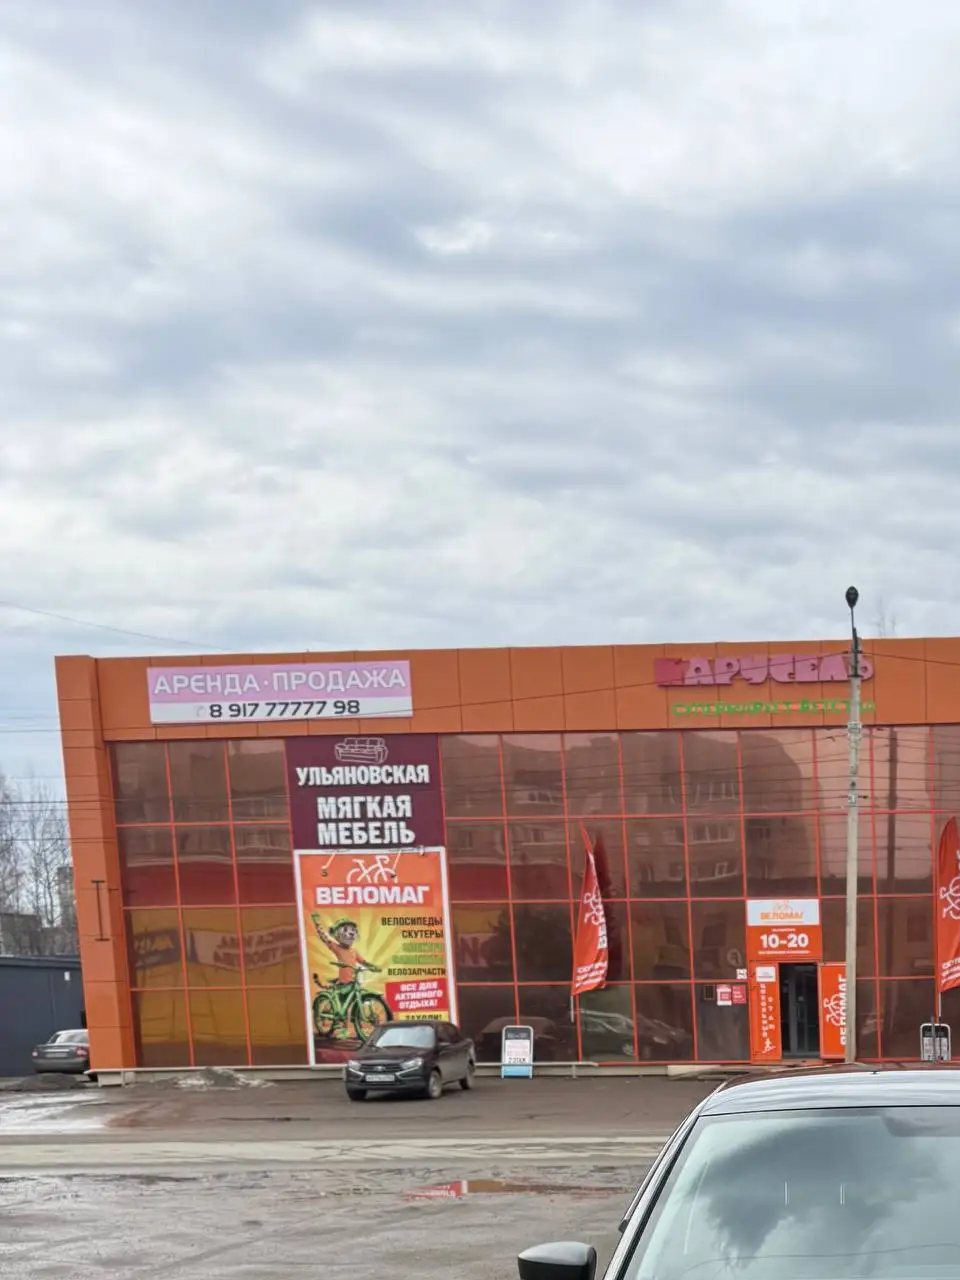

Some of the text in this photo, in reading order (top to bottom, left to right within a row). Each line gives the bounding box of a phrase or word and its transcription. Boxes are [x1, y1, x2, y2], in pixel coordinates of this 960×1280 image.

[154, 668, 406, 696] АРЕНДА ПРОДАЖА
[209, 699, 361, 718] 8 917 77777 98
[295, 764, 430, 786] УЛЬЯНОВСКАЯ
[316, 795, 413, 820] МЯГКАЯ
[316, 821, 416, 845] МЕБЕЛЬ
[315, 885, 430, 905] ВЕЛОМАГ
[381, 916, 444, 927] ВЕЛОСИПЕДЫ
[402, 929, 444, 939] СКУТЕРЫ
[760, 933, 809, 948] 10-20
[388, 967, 446, 976] ВЕЛОЗАПЧАСТИ
